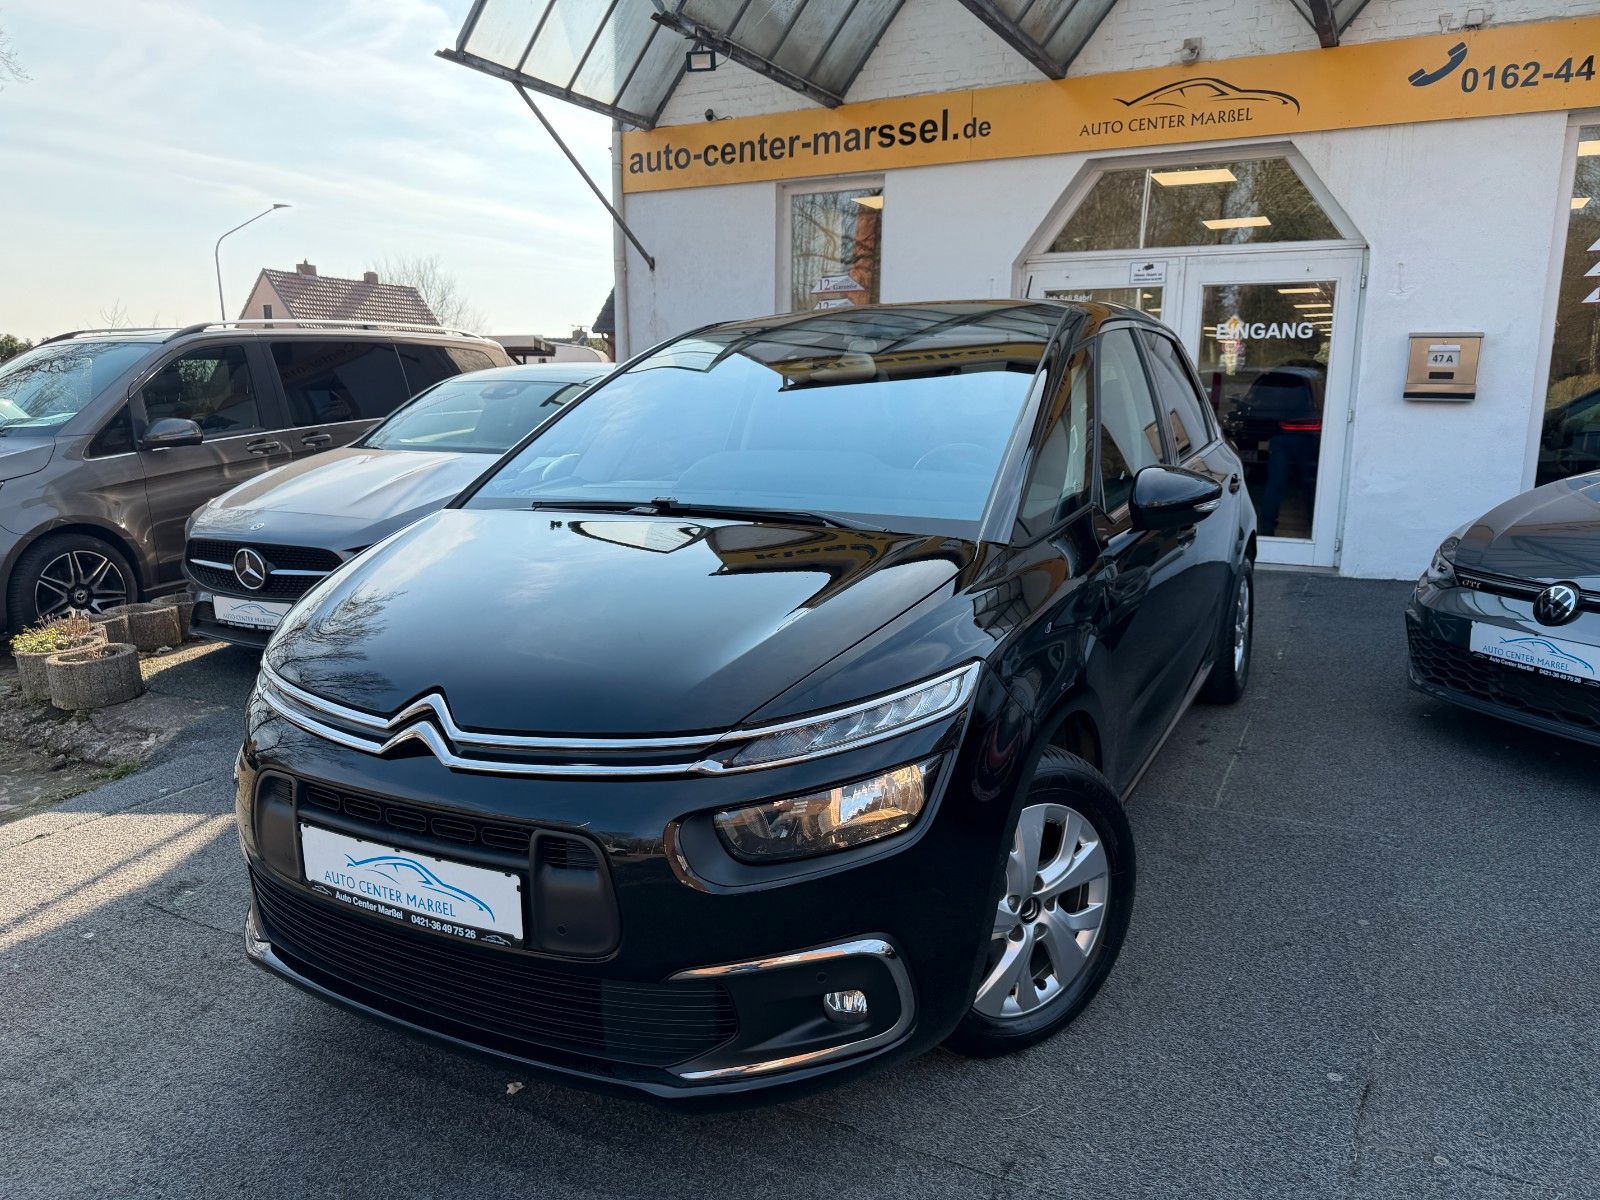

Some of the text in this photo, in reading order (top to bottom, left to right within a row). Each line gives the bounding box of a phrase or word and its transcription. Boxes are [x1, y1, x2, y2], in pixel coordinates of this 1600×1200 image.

[1461, 55, 1596, 93] 0162-44
[1079, 120, 1124, 137] AUTO
[1128, 114, 1185, 132] CENTER
[629, 109, 991, 174] auto-center-marssel.de
[1215, 322, 1314, 340] EINGANG
[1432, 354, 1454, 364] 47 A
[1482, 645, 1504, 656] AUTO
[1505, 650, 1535, 664] CENTER
[324, 870, 356, 889] AUTO
[358, 880, 402, 903] CENTER
[335, 890, 476, 940] Auto Center Marßel 0421-36 49 75 26
